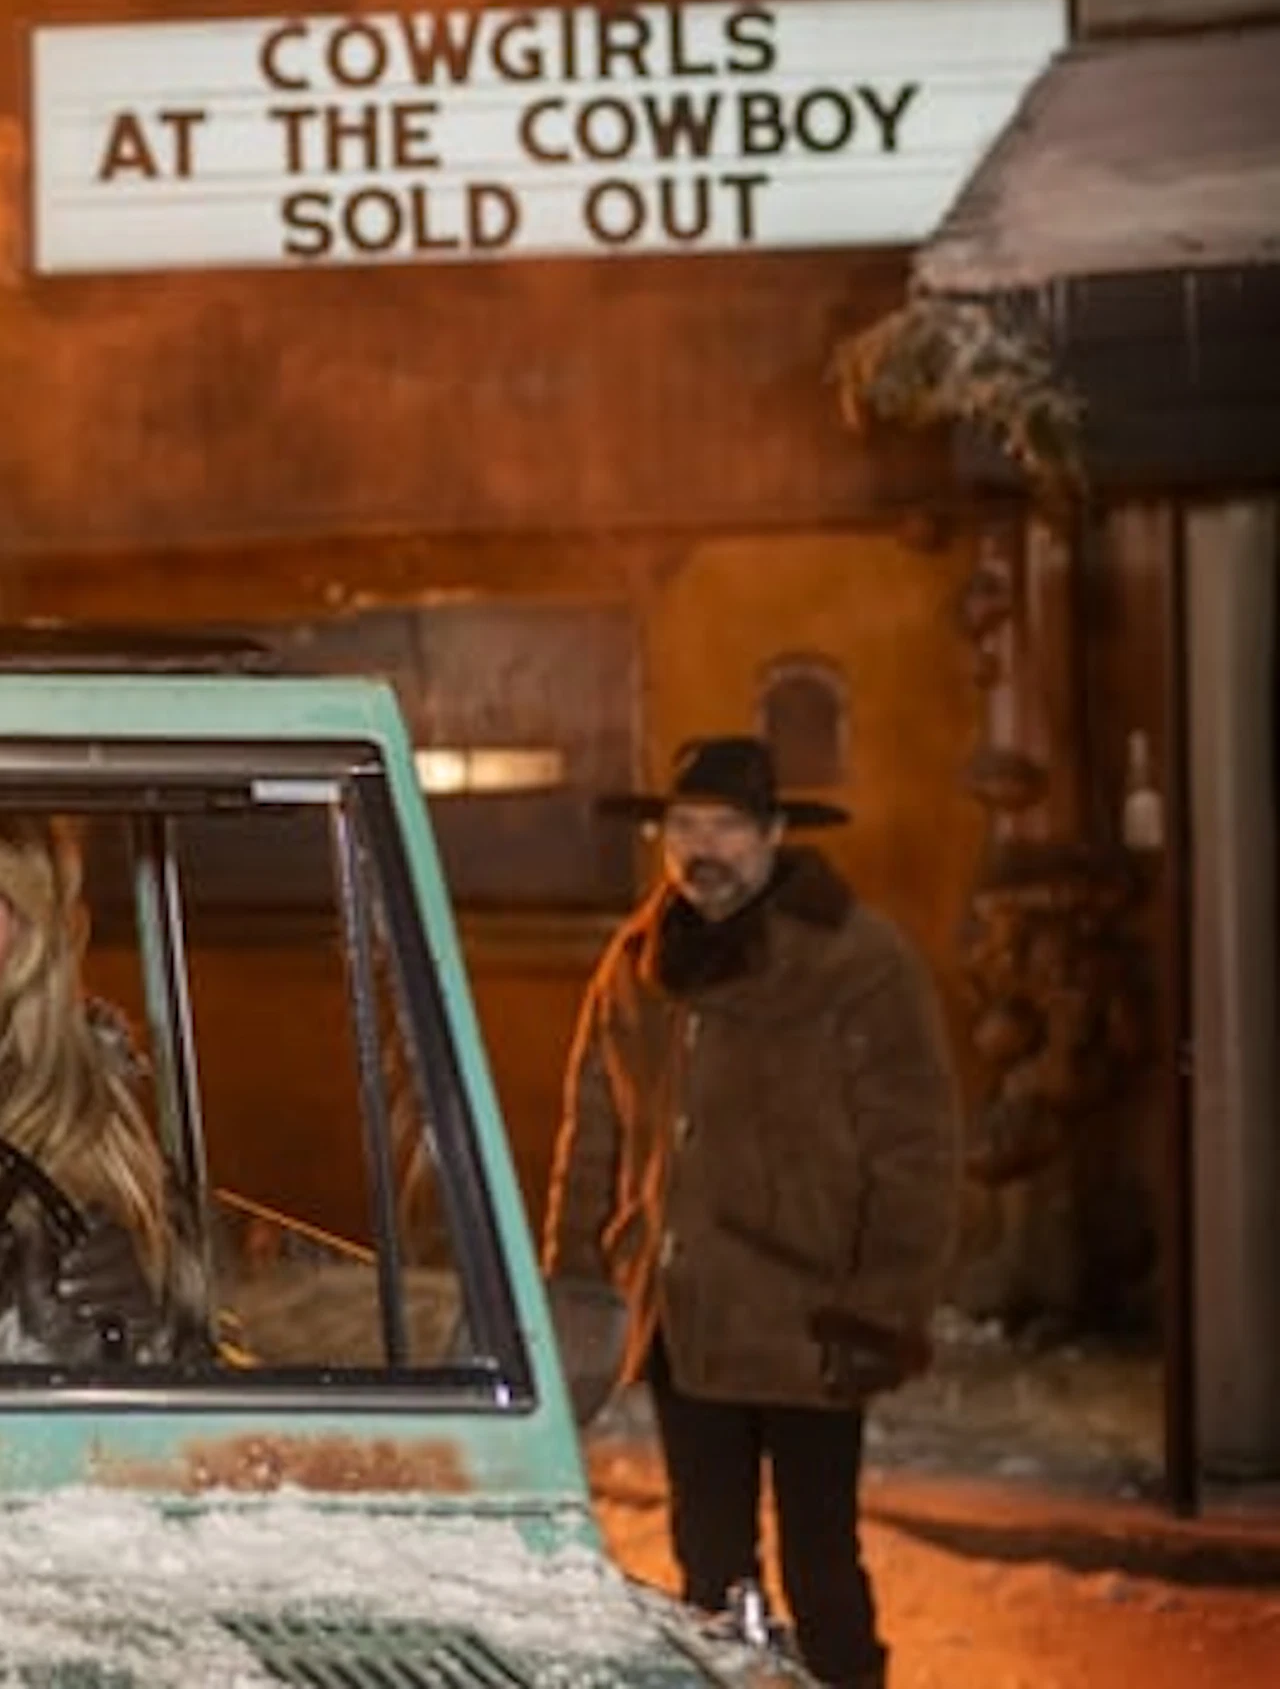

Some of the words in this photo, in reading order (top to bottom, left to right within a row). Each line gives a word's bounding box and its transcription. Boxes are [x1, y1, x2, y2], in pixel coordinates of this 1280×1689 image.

[257, 8, 779, 92] COWGIRLS
[95, 110, 206, 182] AT
[268, 98, 442, 174] THE
[515, 84, 920, 164] COWBOY
[280, 183, 522, 258] SOLD
[582, 174, 770, 245] OUT
